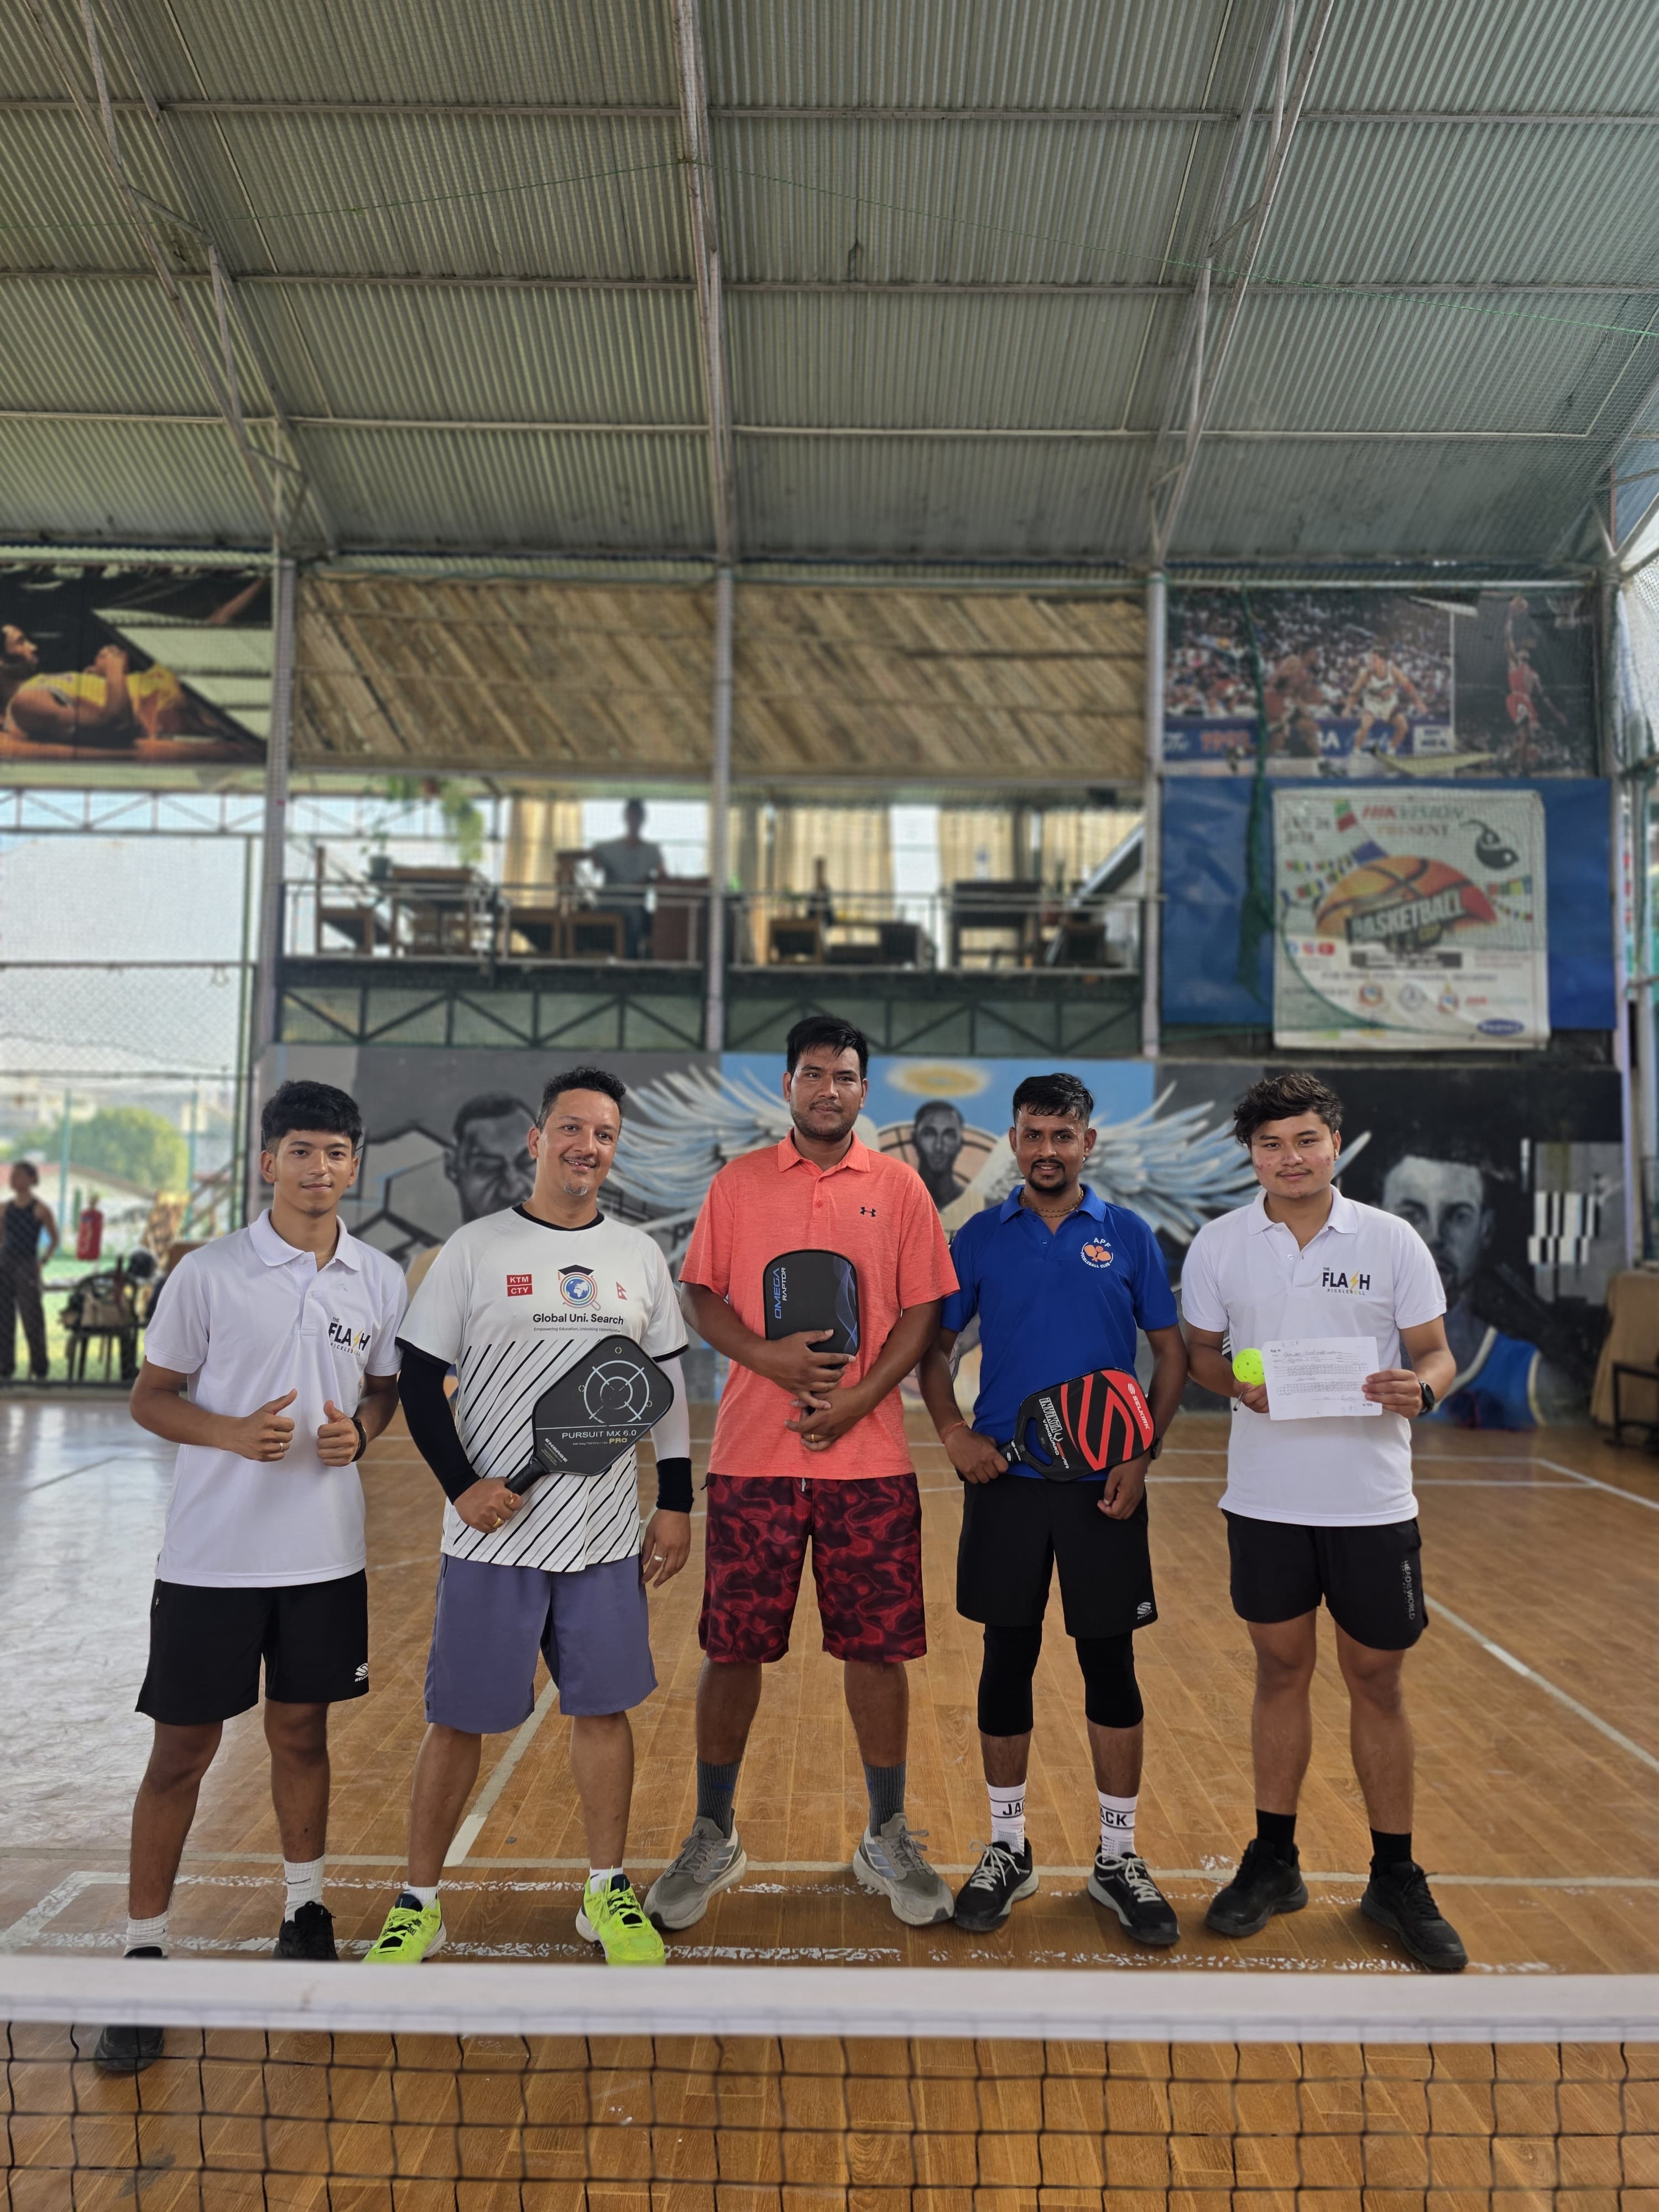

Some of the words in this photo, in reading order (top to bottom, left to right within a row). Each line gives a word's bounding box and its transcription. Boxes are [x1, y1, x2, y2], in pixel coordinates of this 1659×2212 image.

[1351, 889, 1465, 940] BASKETBALL
[1093, 1237, 1112, 1248] APF
[510, 1286, 529, 1295] CTY
[773, 1267, 782, 1319] OMEGA
[533, 1313, 567, 1323] Global
[570, 1313, 588, 1323] Uni.
[591, 1314, 624, 1326] Search
[1132, 1395, 1151, 1431] SELKIRK
[562, 1431, 604, 1439] PURSUIT
[1043, 1418, 1060, 1455] VANGUARD
[545, 1438, 568, 1463] ENGAGE
[1100, 1807, 1128, 1827] ACK
